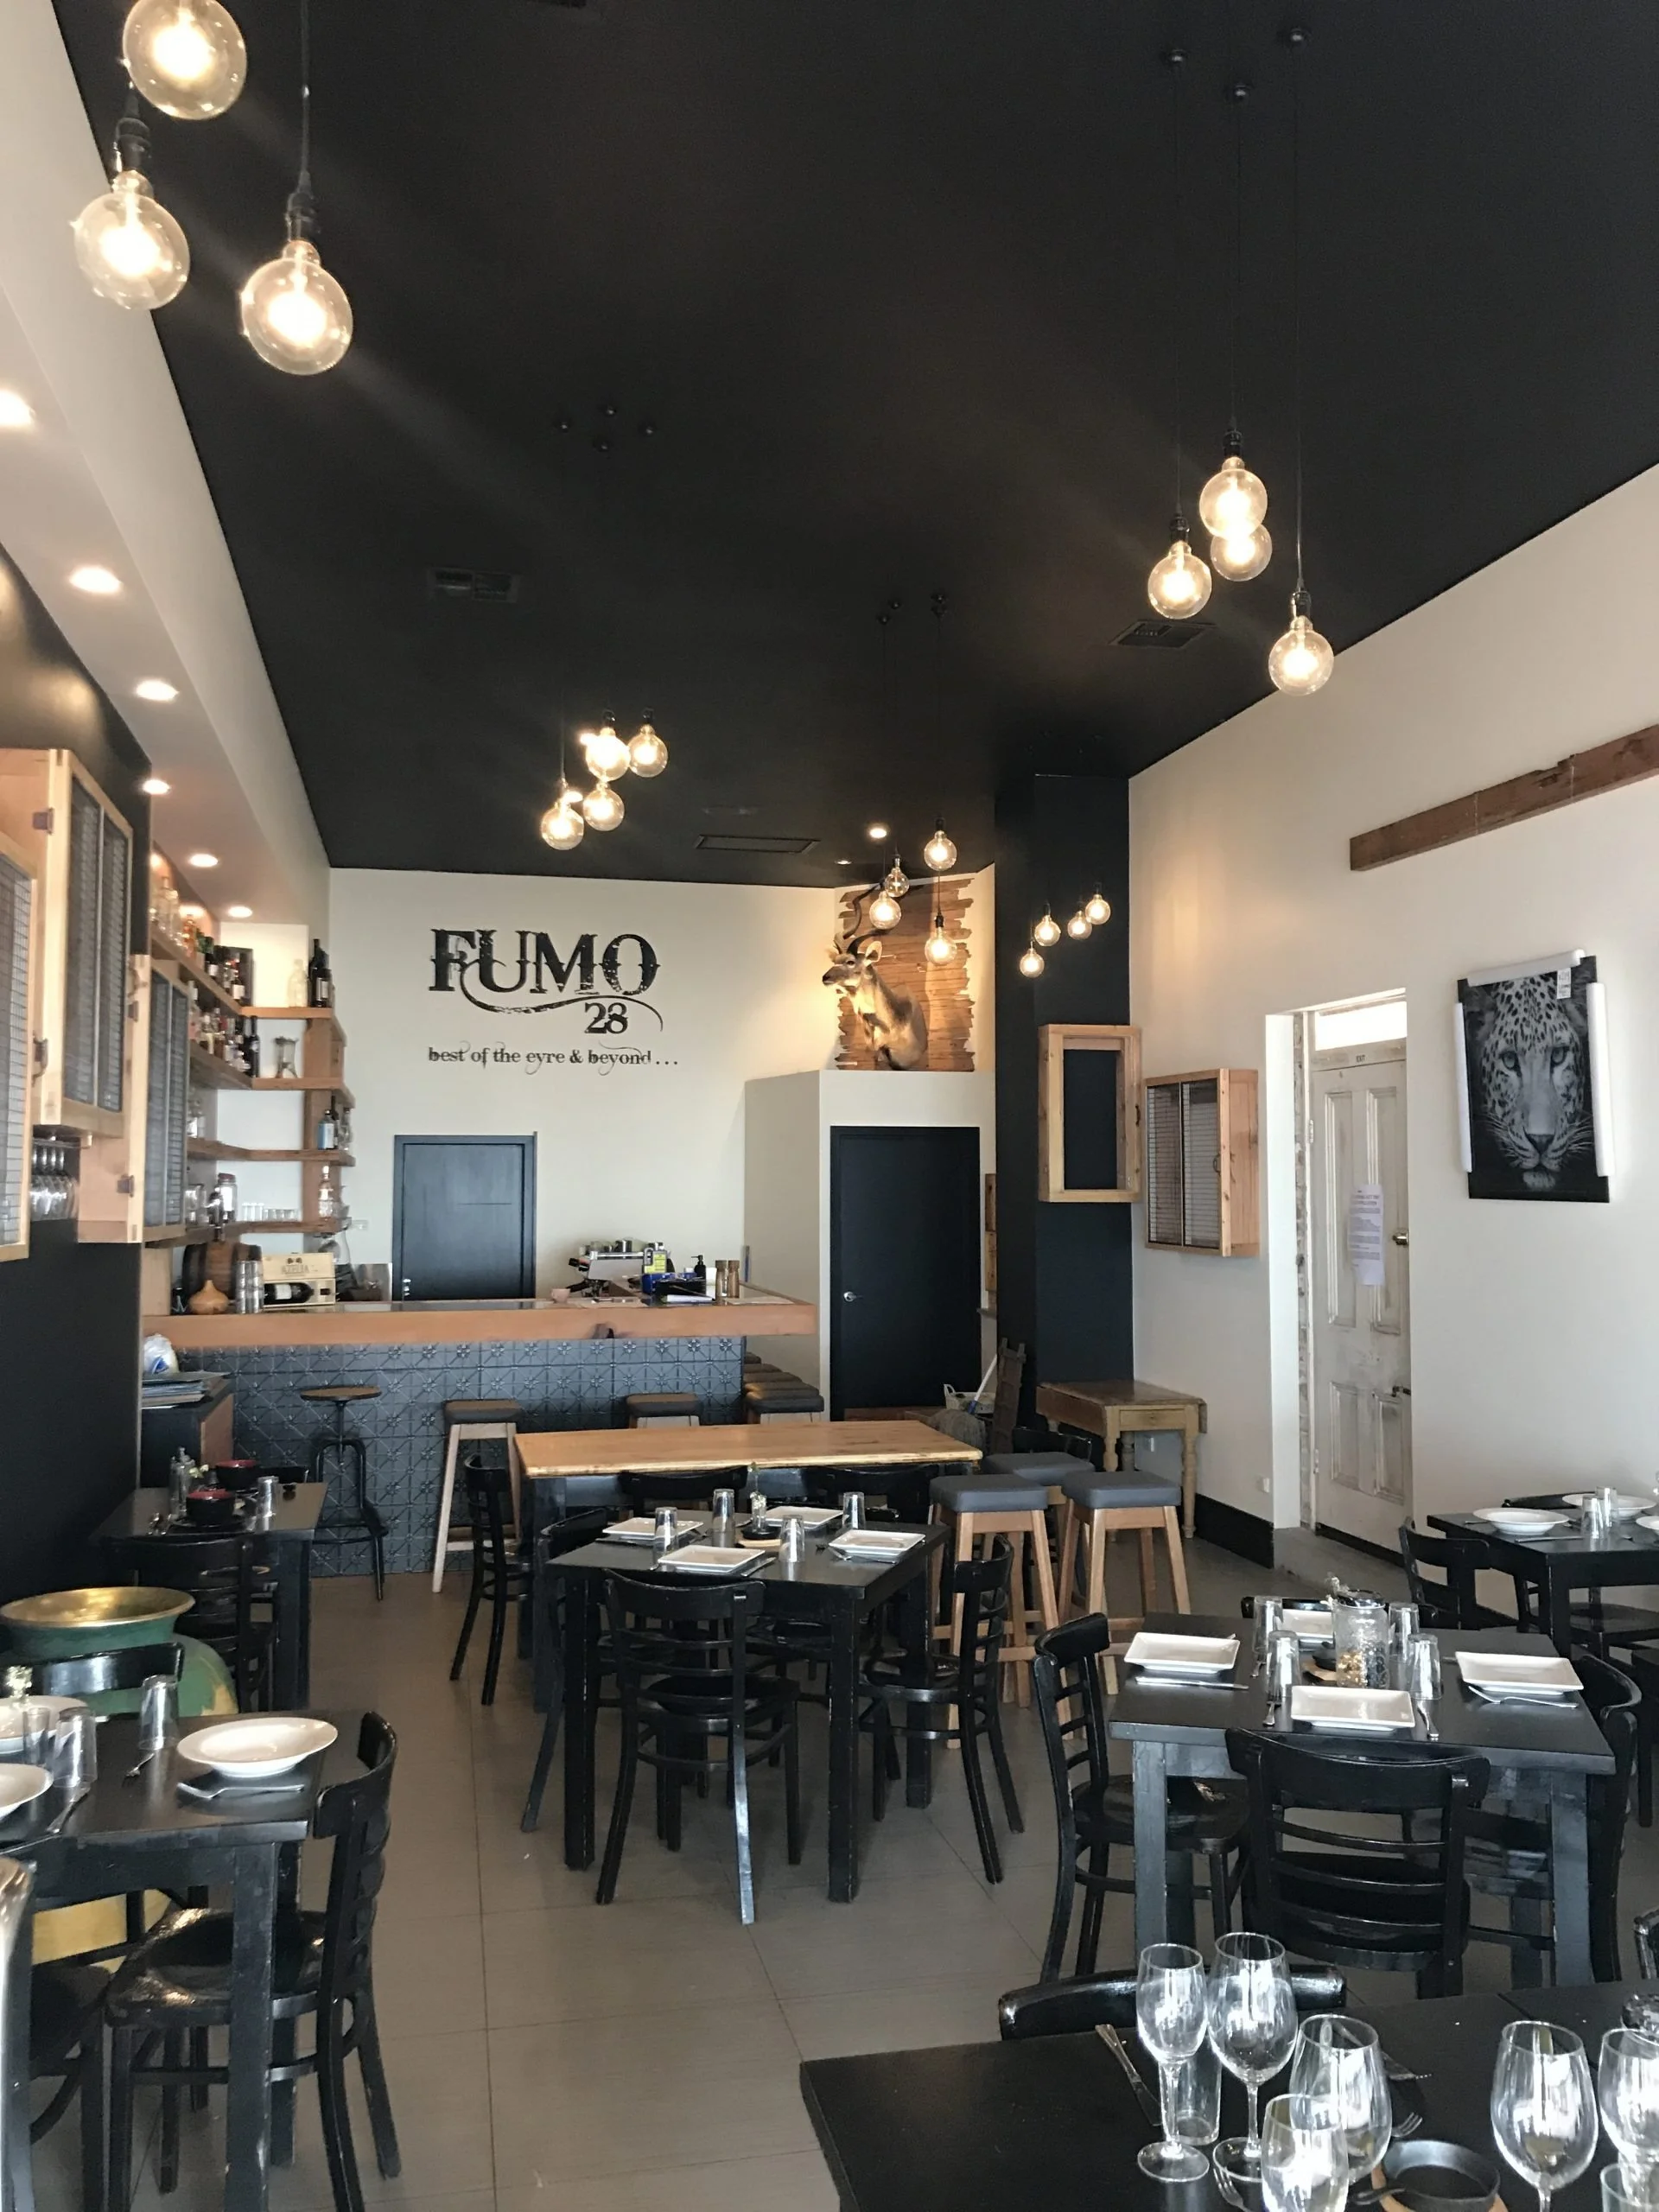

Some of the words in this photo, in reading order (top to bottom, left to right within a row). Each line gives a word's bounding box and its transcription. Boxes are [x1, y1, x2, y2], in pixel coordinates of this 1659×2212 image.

[429, 928, 661, 999] FUMO
[584, 1001, 628, 1034] 28
[429, 1042, 471, 1062] best
[471, 1047, 491, 1070] of
[493, 1042, 521, 1063] the
[525, 1051, 565, 1075] eyre
[569, 1049, 584, 1064] &
